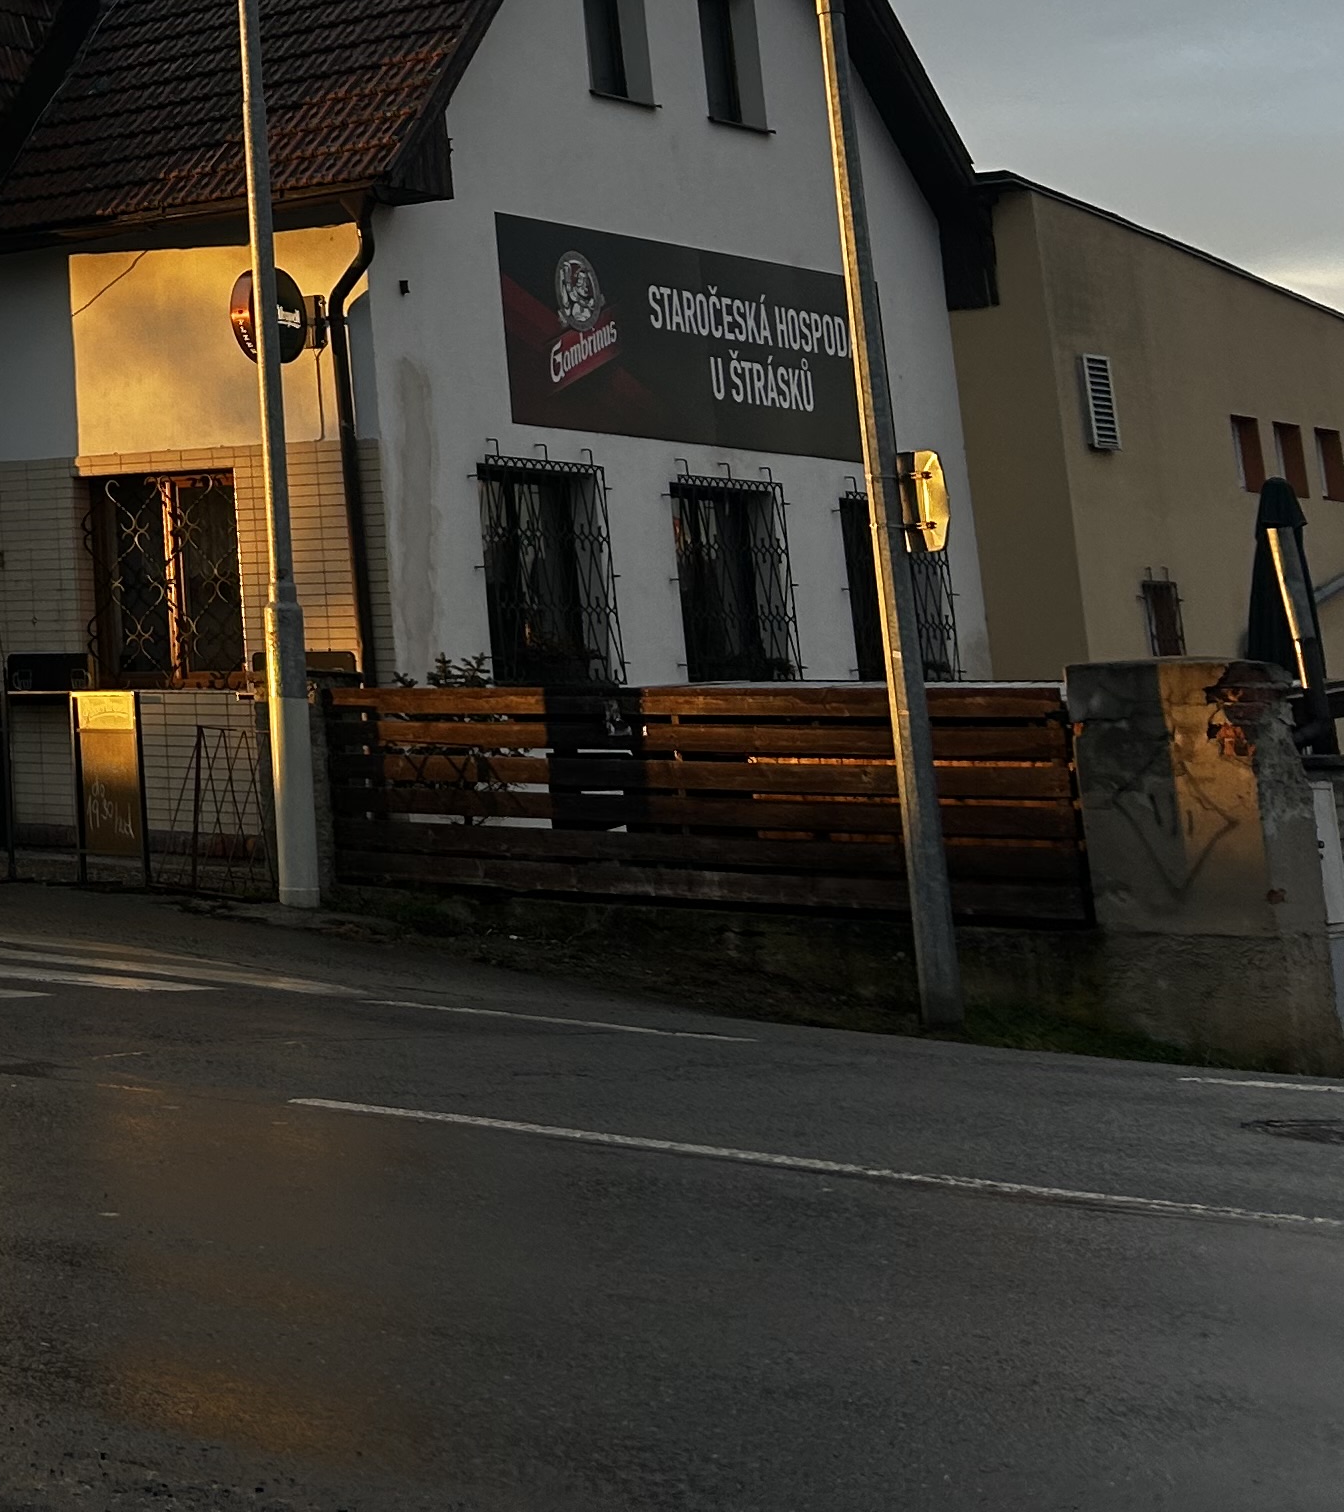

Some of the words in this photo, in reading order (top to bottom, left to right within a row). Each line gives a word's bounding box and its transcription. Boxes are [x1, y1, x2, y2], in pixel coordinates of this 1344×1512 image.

[550, 320, 618, 383] Gambrinus
[648, 284, 773, 346] STAROČESKÁ
[774, 305, 853, 360] HOSPOD
[710, 356, 725, 400] U
[729, 349, 814, 412] ŠTRÁSKŮ
